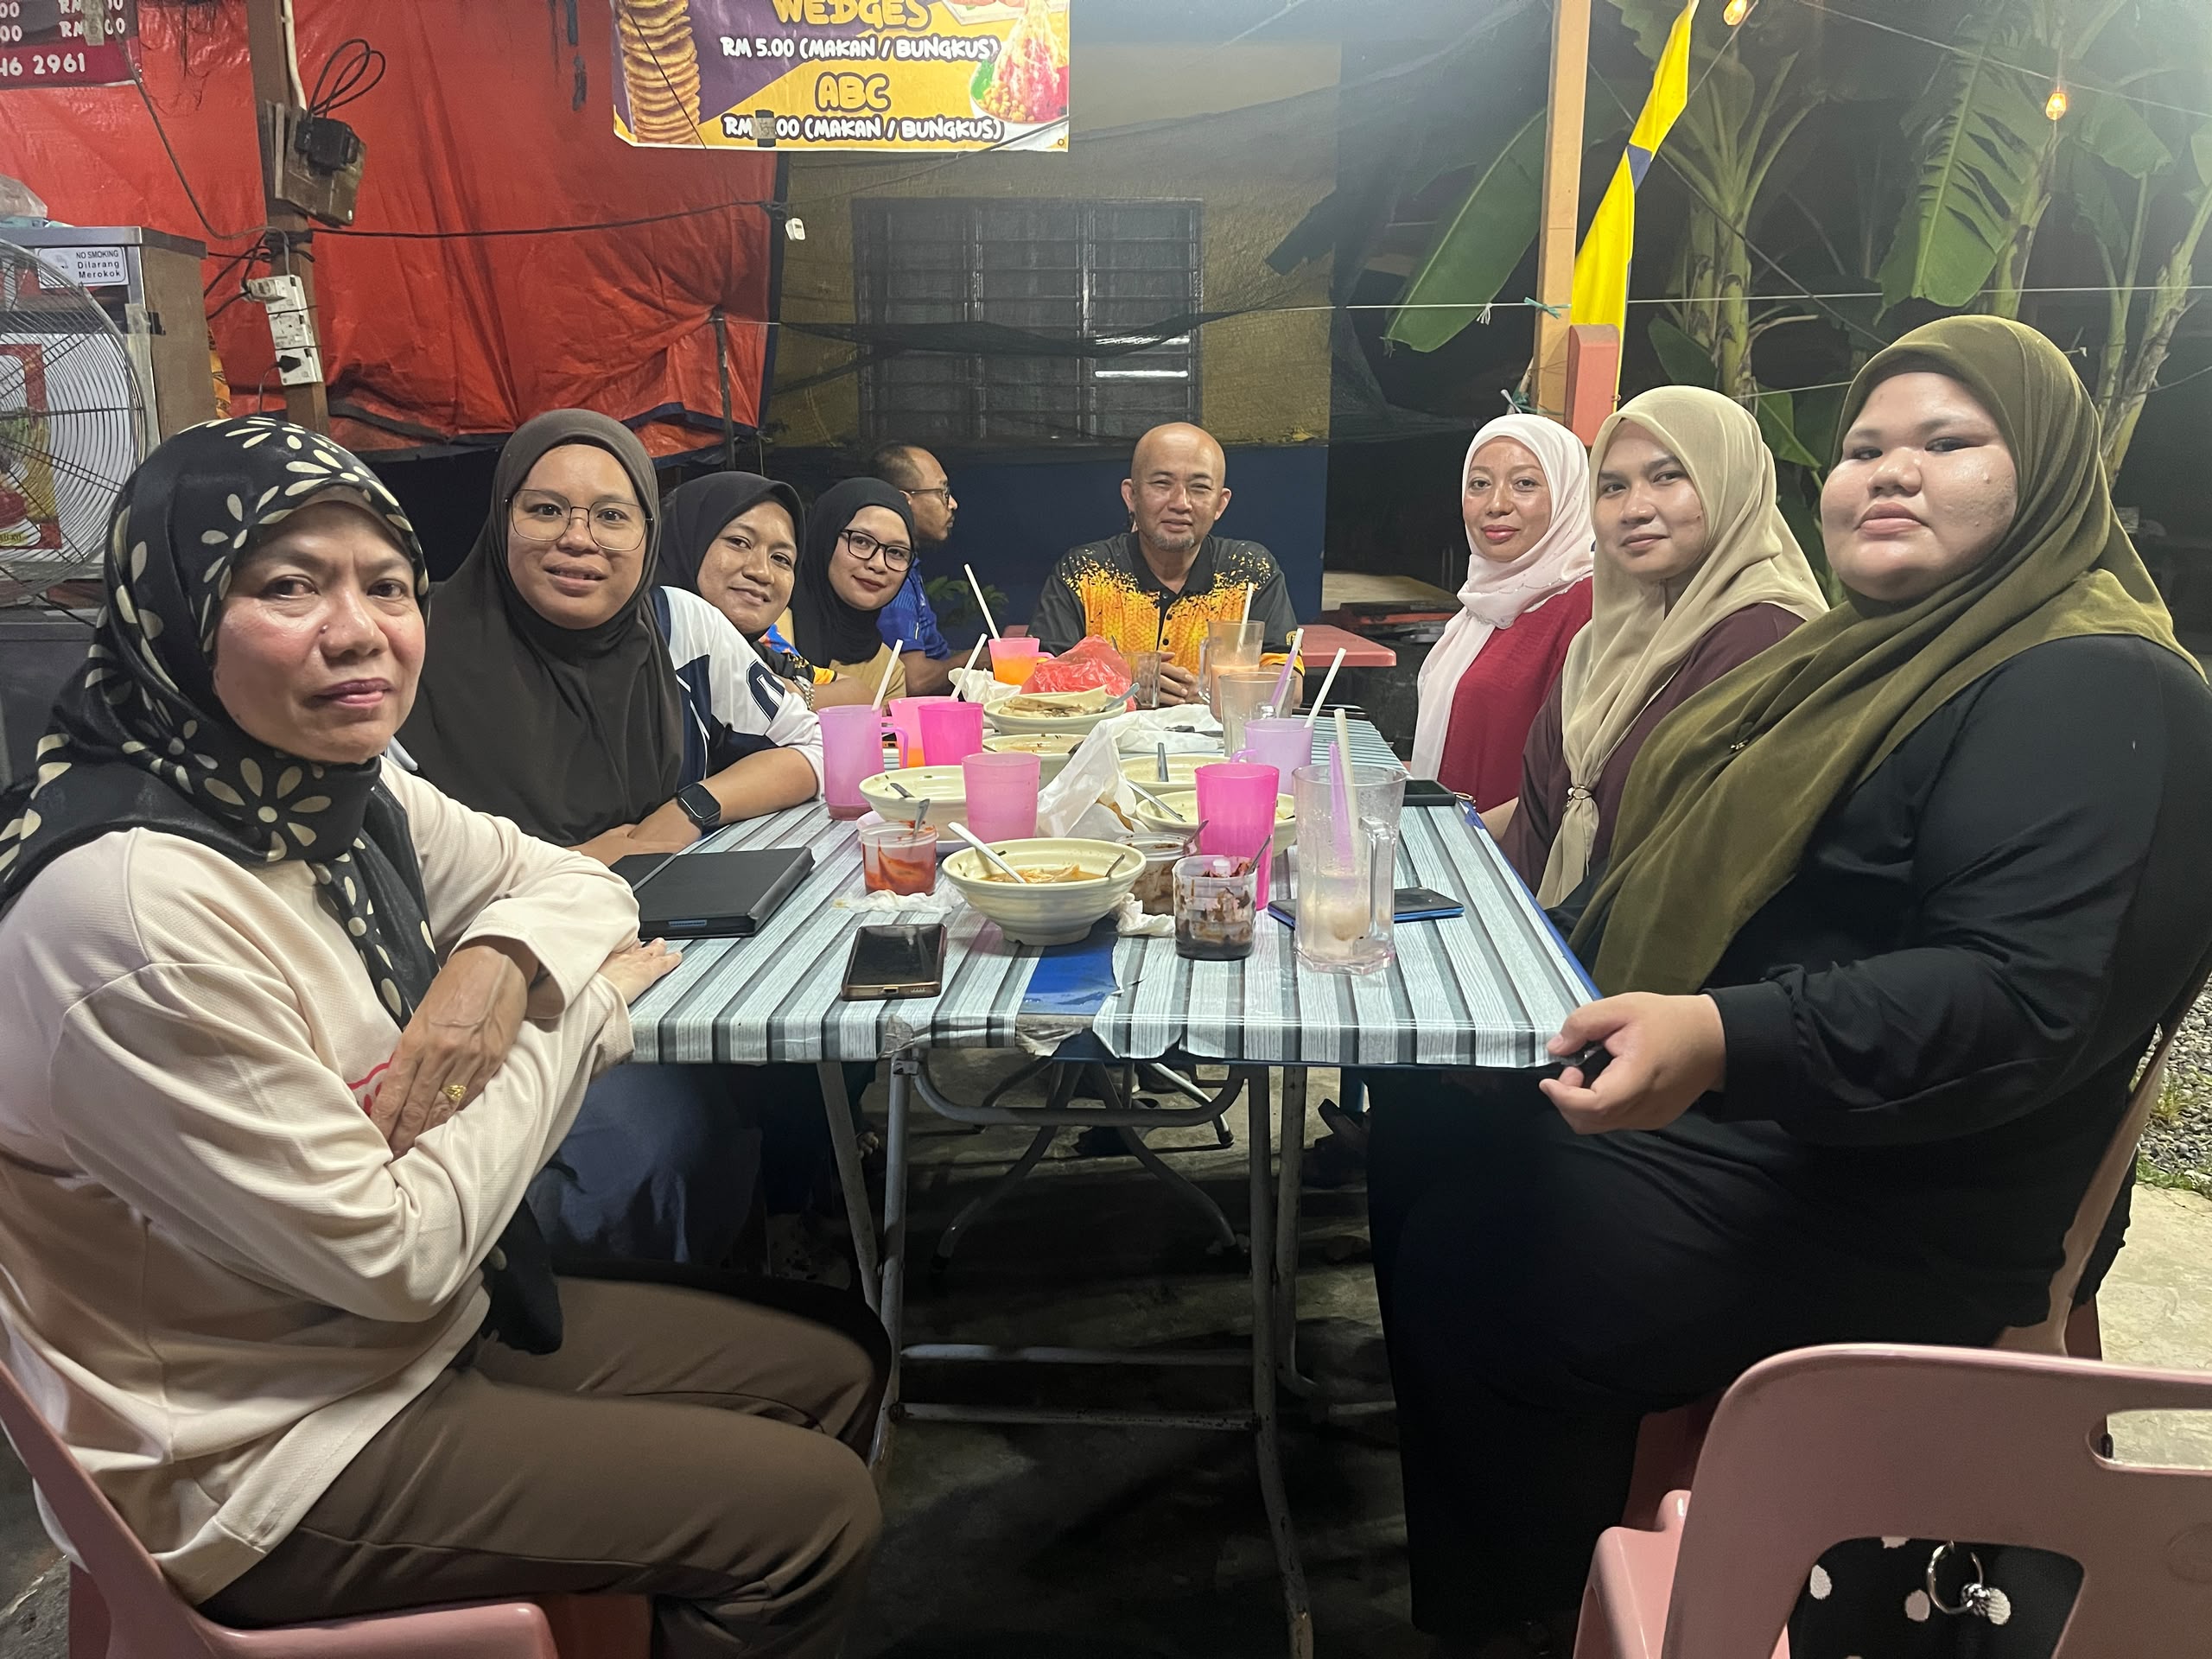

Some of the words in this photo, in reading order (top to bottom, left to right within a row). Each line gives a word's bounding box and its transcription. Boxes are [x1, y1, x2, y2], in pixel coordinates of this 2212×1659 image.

[772, 0, 929, 29] WEDGES
[720, 36, 752, 58] RM
[756, 38, 795, 57] 5.00
[799, 37, 876, 59] (MAKAN
[895, 36, 999, 60] BUNGKUS)
[33, 53, 86, 74] 2961
[817, 74, 889, 110] ABC
[804, 118, 881, 139] (MAKAN
[901, 118, 1001, 139] BUNGKUS)
[87, 250, 119, 258] SMOKING
[79, 270, 121, 278] Merokok
